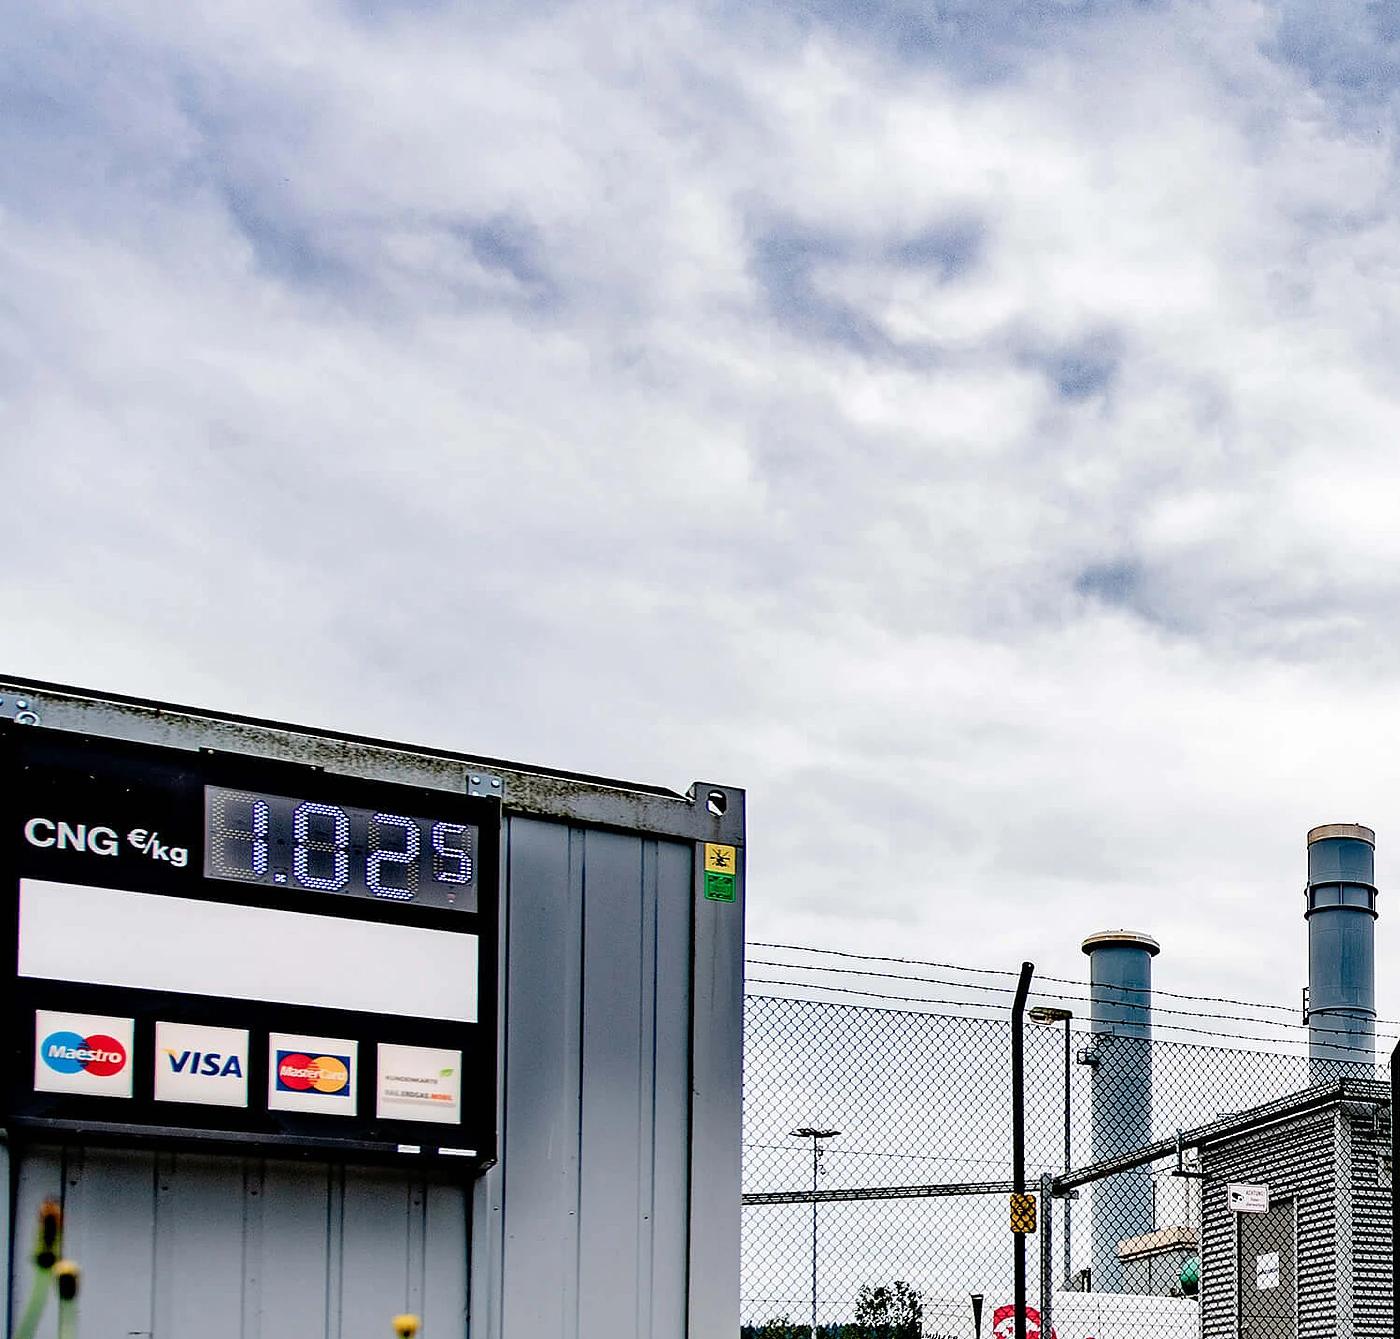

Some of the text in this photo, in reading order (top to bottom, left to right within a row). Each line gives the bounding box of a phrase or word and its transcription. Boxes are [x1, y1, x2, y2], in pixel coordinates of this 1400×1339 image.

[24, 818, 188, 867] CNG €/kg
[252, 799, 473, 901] 1.025
[48, 1045, 123, 1064] Maestro
[164, 1049, 243, 1078] VISA
[280, 1065, 348, 1081] MasterCard
